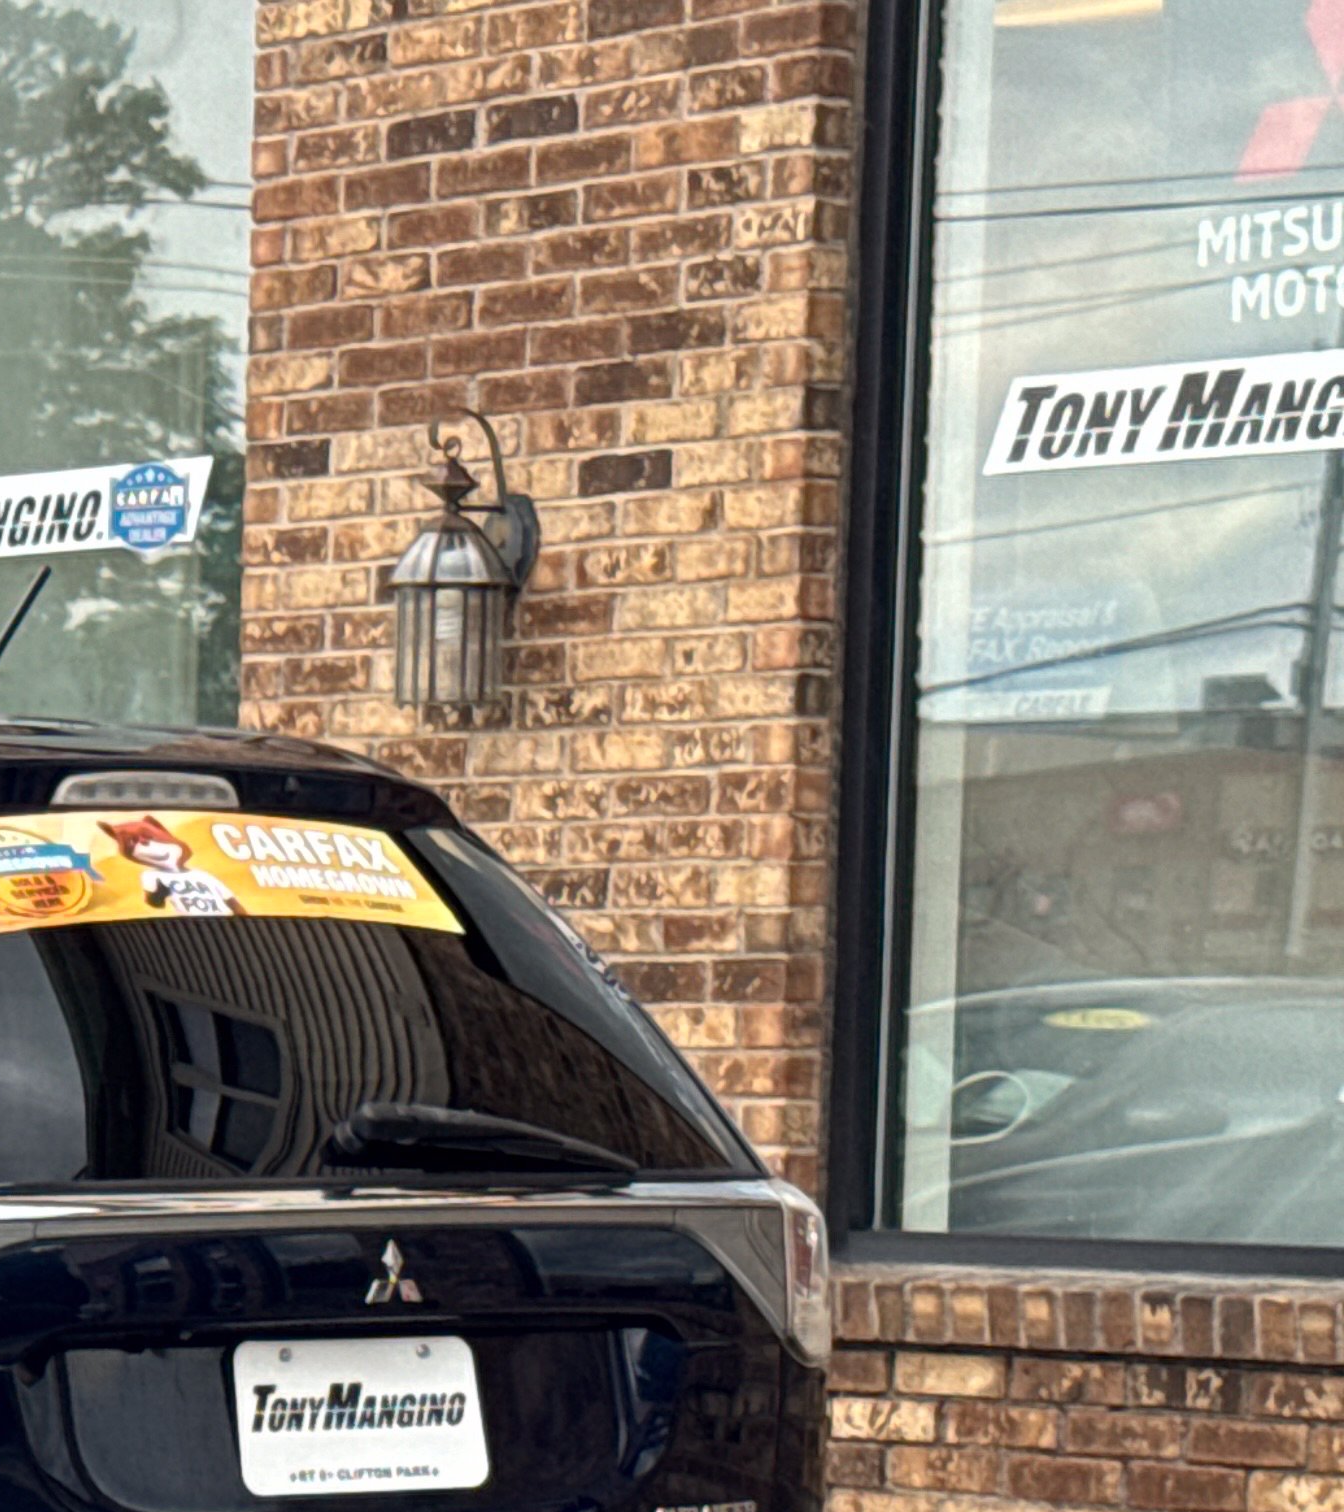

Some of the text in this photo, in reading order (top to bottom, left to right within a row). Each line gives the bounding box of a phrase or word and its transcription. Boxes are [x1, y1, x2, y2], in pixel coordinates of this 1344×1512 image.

[1006, 384, 1167, 463] TONY
[211, 823, 401, 874] CARFAX
[169, 879, 214, 895] CAR
[249, 864, 417, 900] HOMEGROWN
[179, 896, 222, 913] FOX
[336, 1466, 392, 1480] CLIFTON
[396, 1465, 430, 1478] PARK
